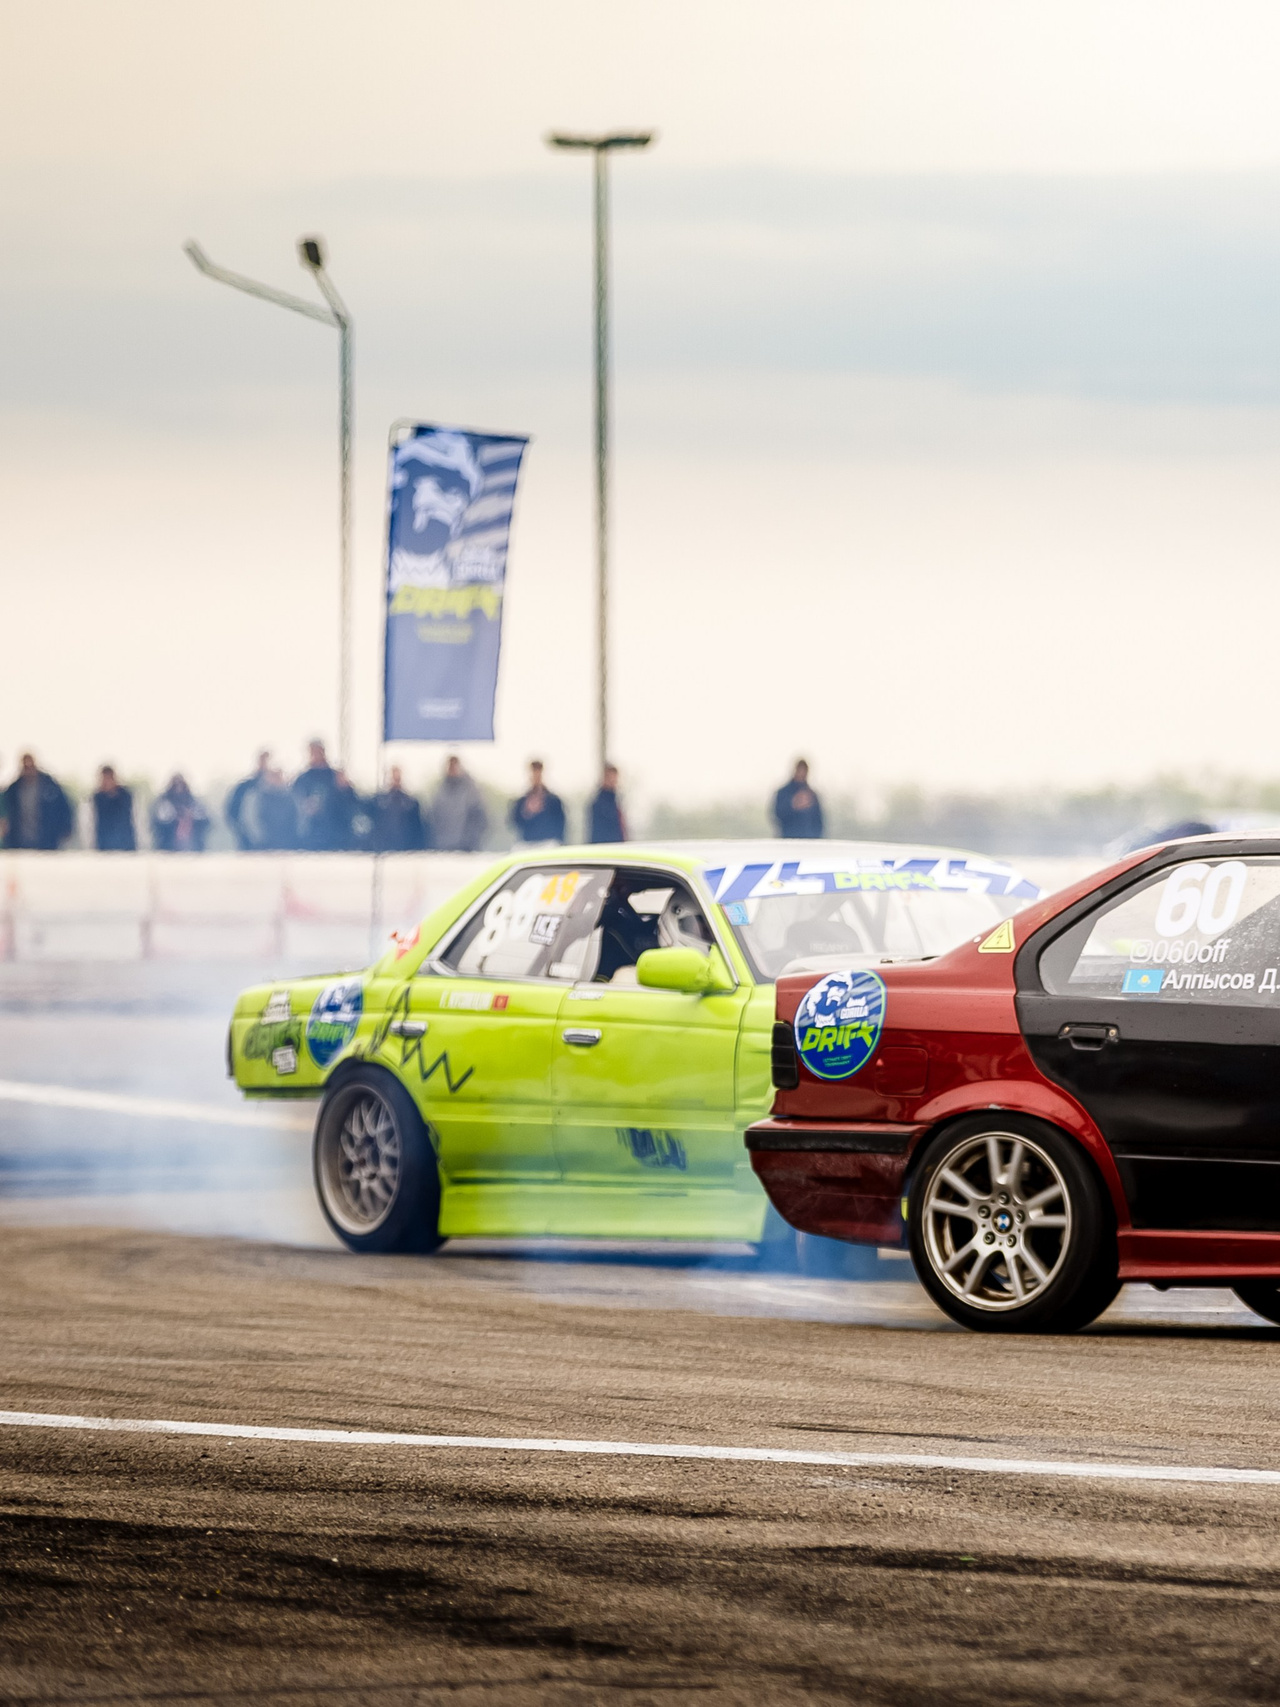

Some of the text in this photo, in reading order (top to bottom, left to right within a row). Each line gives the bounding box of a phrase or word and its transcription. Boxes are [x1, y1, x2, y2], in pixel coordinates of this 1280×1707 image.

[540, 870, 581, 905] 48
[833, 871, 940, 892] DRIFT
[1155, 861, 1247, 937] 60
[1152, 938, 1232, 963] 060off
[1161, 968, 1255, 990] Алпысов
[801, 1020, 876, 1053] DRIFT
